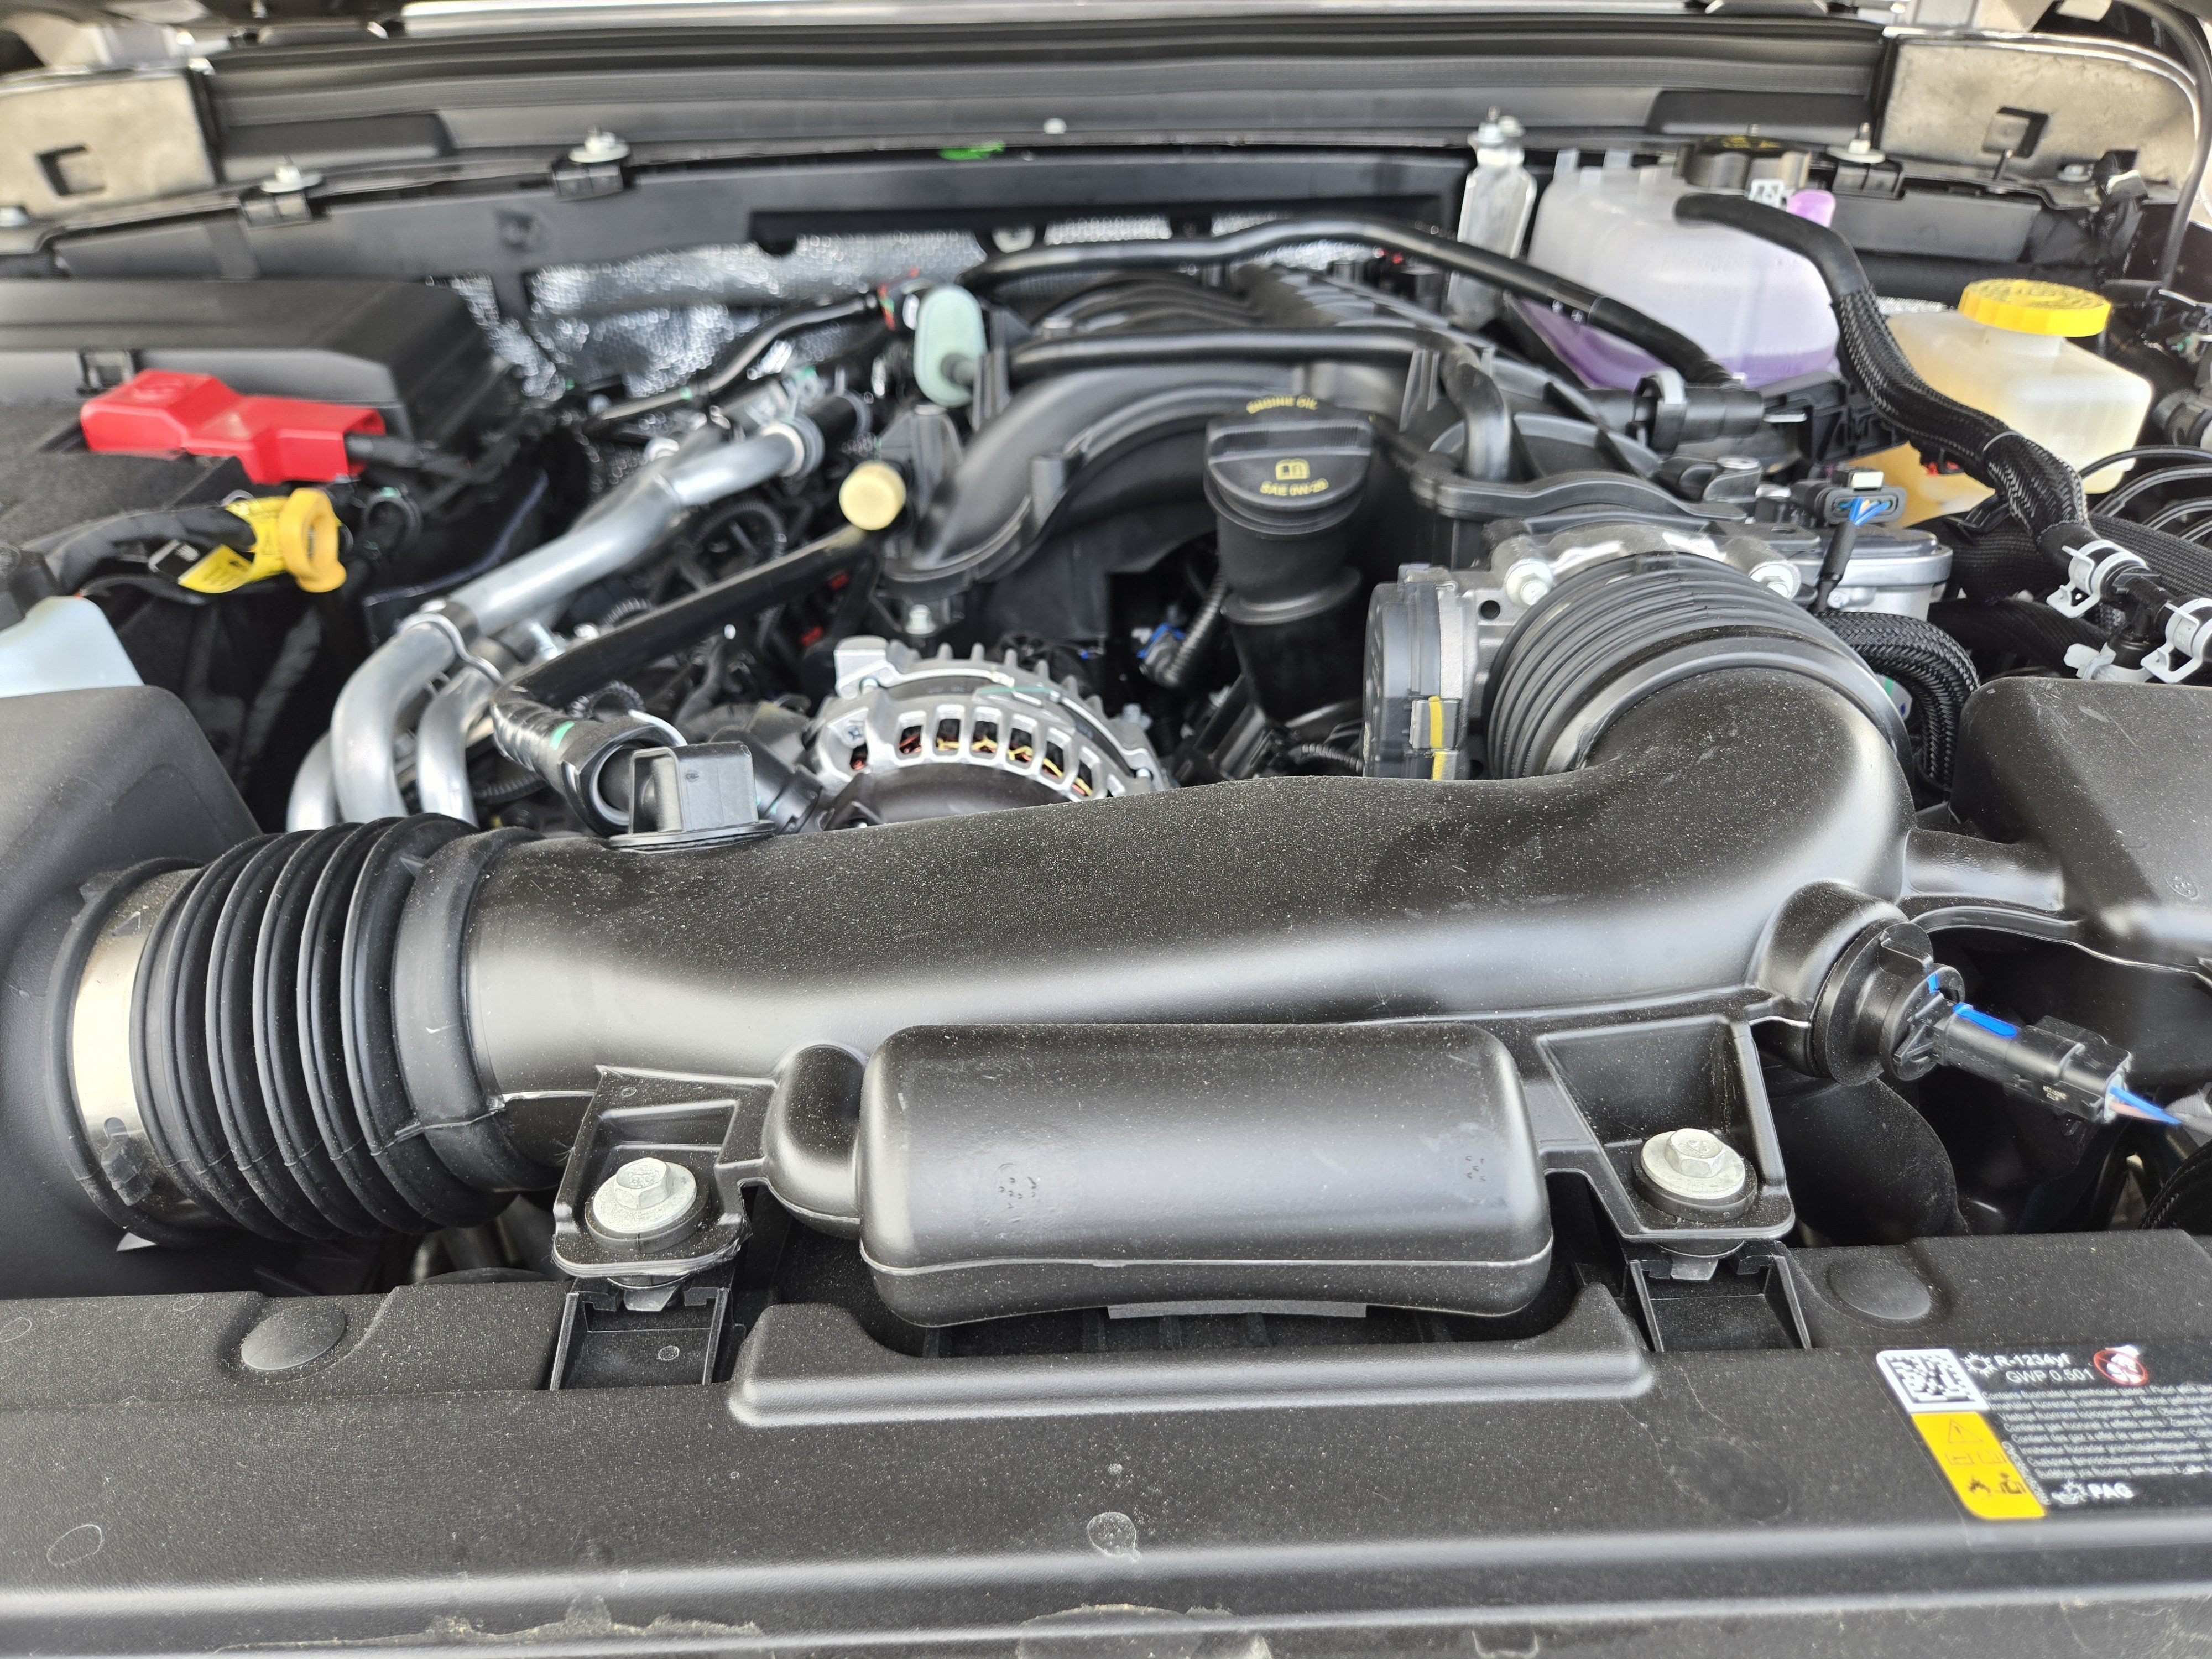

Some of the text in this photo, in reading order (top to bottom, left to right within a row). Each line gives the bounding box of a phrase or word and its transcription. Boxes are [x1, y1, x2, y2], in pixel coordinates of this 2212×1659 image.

[1246, 395, 1318, 414] ENGINE OIL
[1260, 478, 1329, 497] SAE 0W-20
[1994, 1352, 2071, 1368] R-1234yf
[2005, 1368, 2095, 1384] GWP 0.501
[2087, 1483, 2135, 1499] PAG
